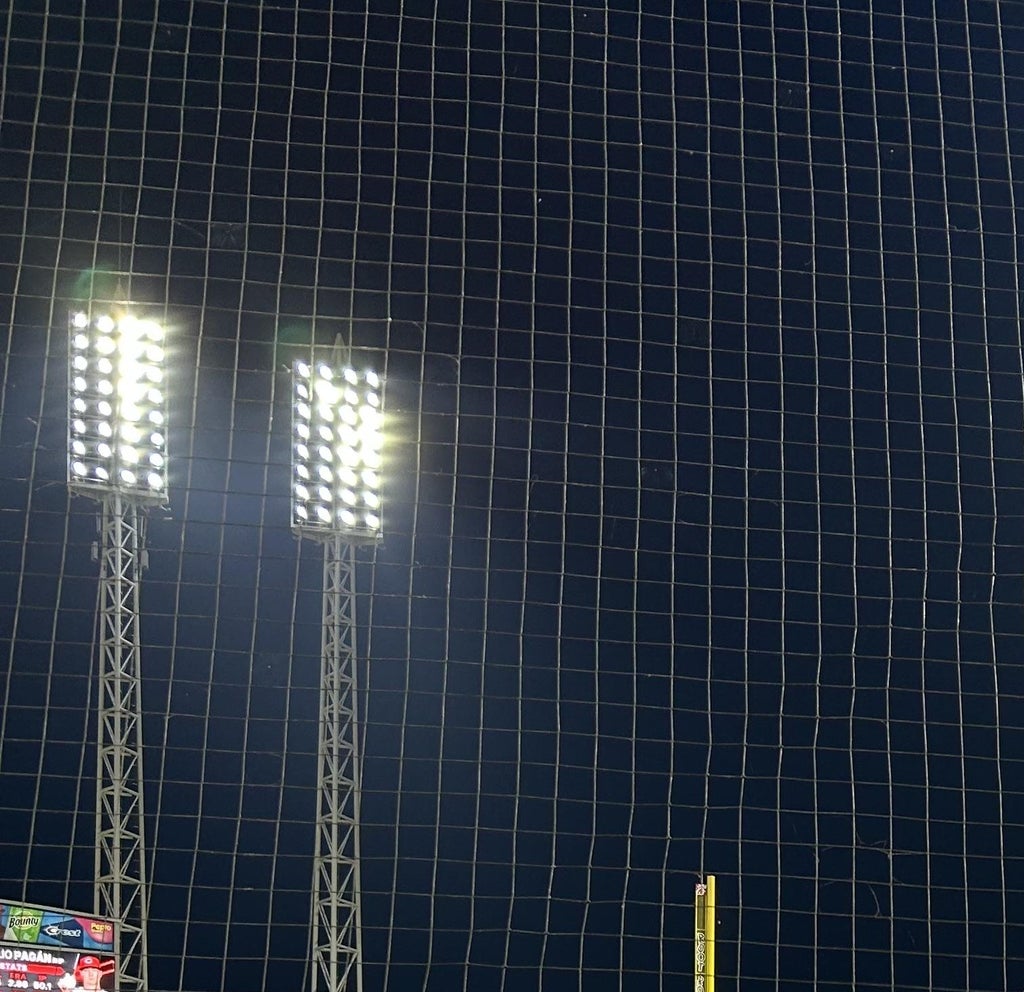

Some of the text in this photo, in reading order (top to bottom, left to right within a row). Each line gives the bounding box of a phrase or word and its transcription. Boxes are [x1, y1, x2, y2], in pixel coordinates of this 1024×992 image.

[9, 917, 39, 928] Bounty
[46, 926, 81, 937] Crest
[13, 950, 52, 963] PAGÁN
